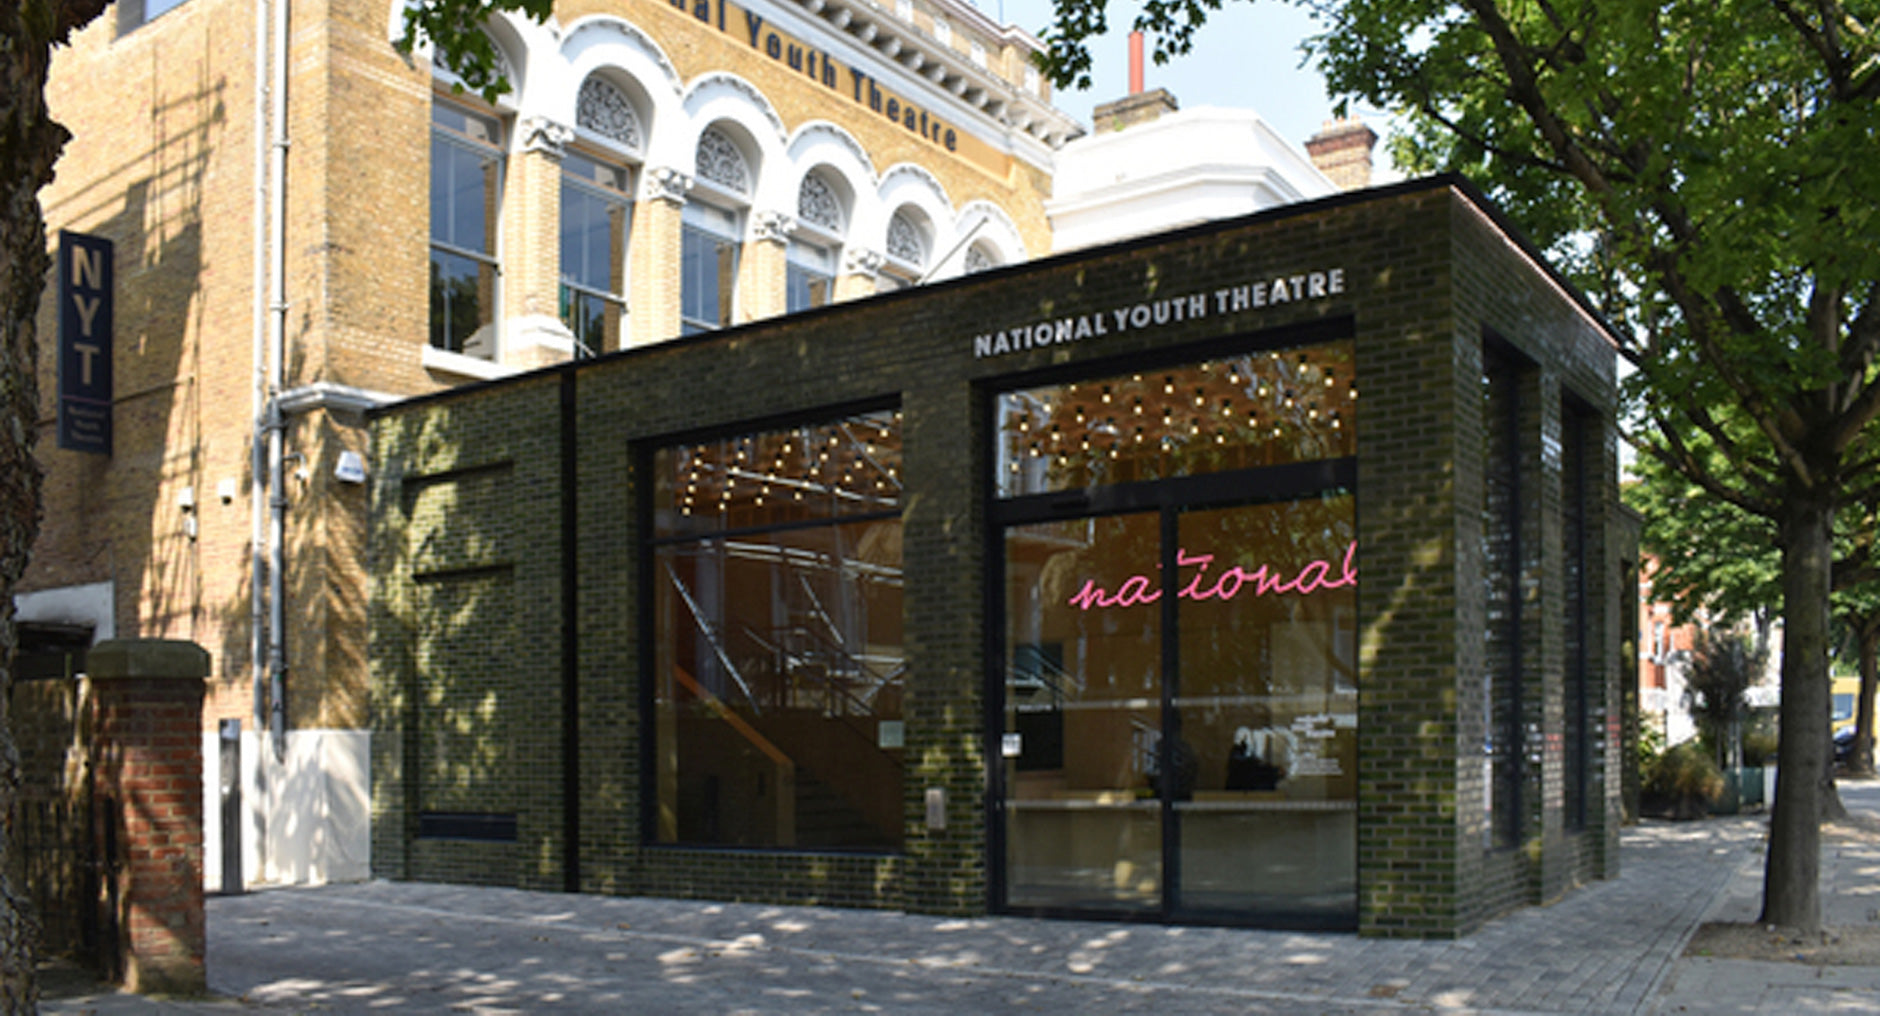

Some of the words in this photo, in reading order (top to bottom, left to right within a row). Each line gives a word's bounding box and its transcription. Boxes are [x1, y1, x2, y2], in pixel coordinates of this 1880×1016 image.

[745, 10, 837, 89] Youth
[849, 66, 957, 152] Theatre
[71, 244, 101, 385] NYT
[974, 314, 1107, 357] NATIONAL
[1114, 294, 1206, 331] YOUTH
[1215, 268, 1344, 313] THEATRE
